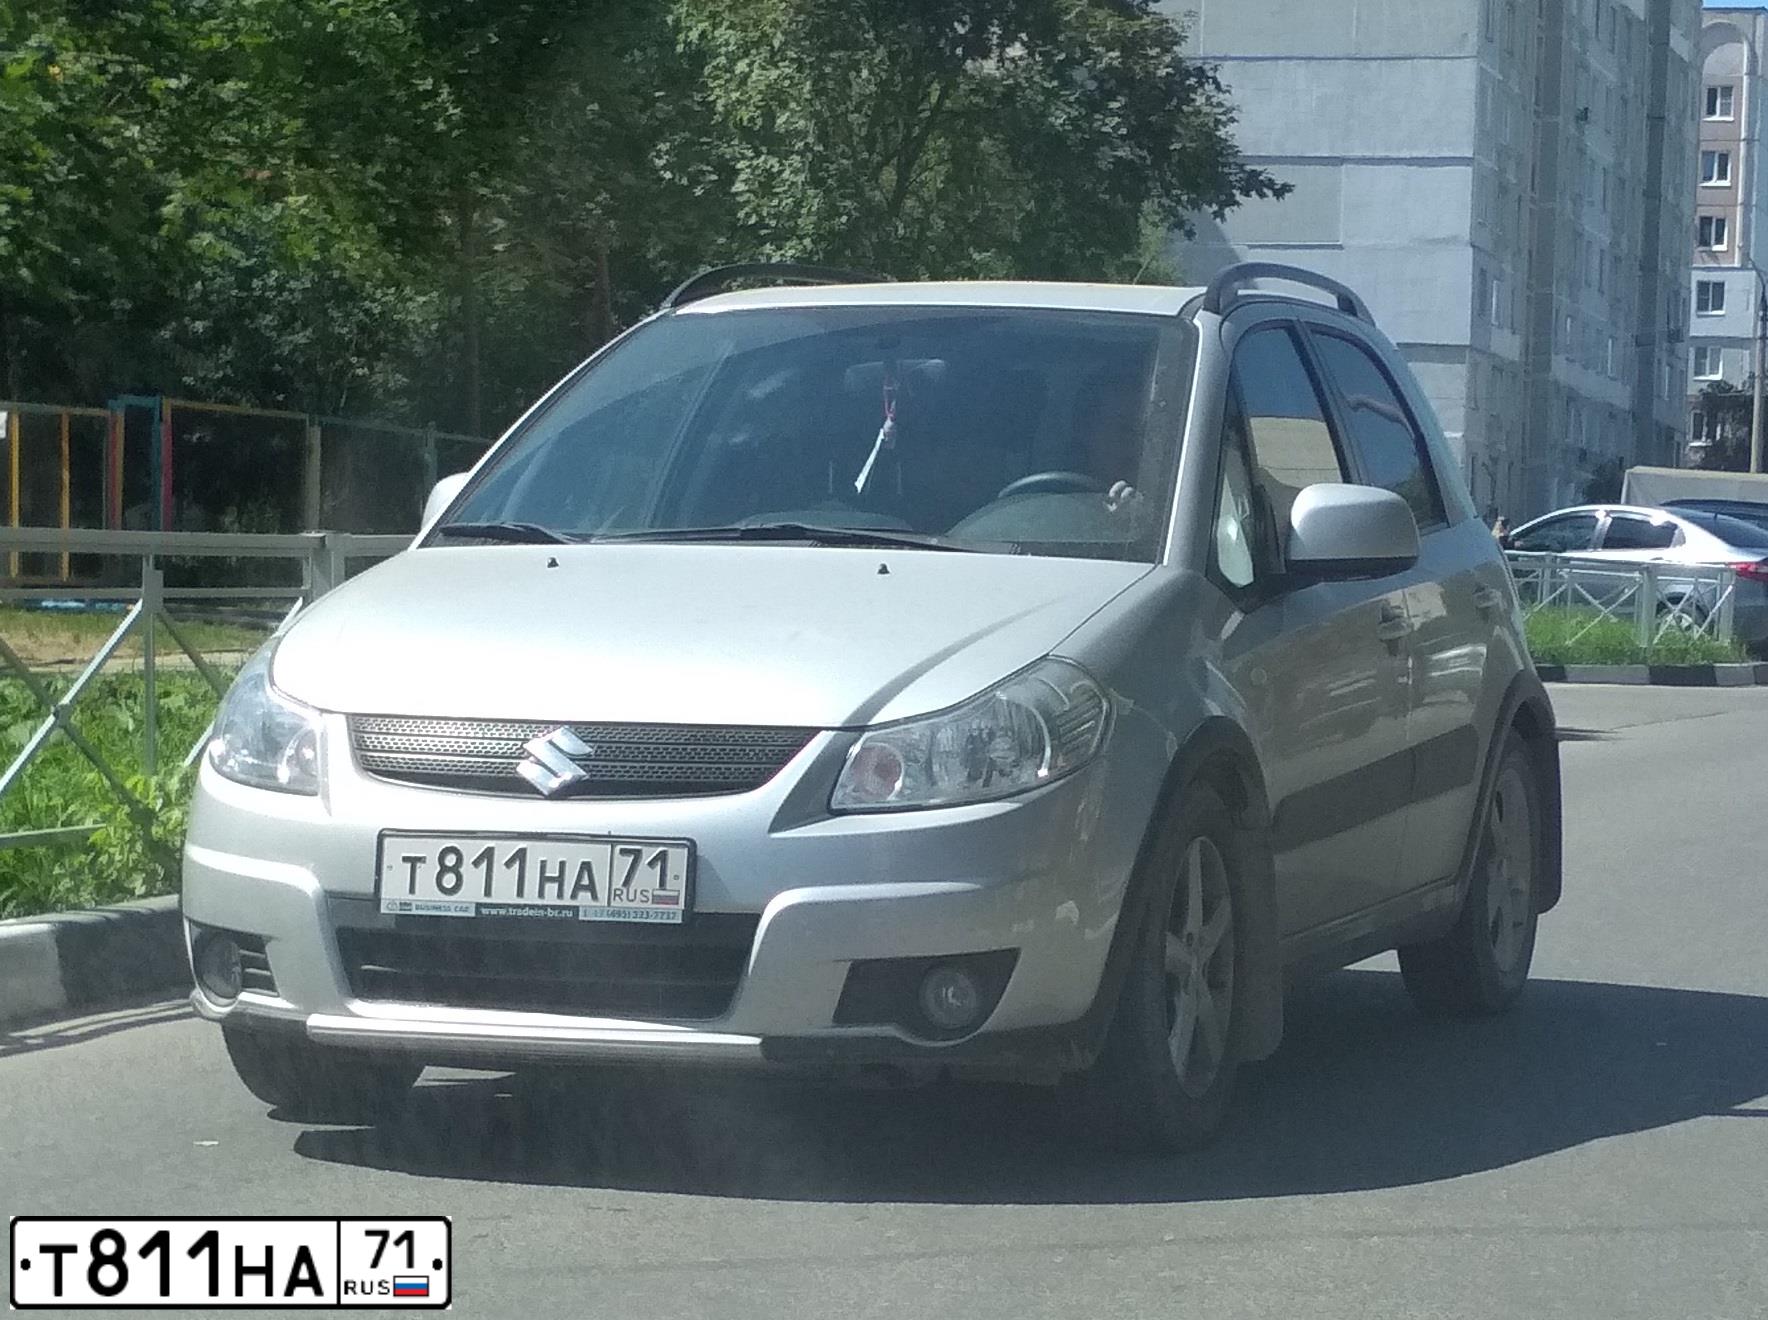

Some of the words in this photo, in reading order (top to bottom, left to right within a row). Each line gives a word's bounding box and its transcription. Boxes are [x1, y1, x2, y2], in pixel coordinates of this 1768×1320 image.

[401, 845, 599, 901] Т811НА
[618, 846, 669, 890] 71
[613, 888, 650, 903] RUS
